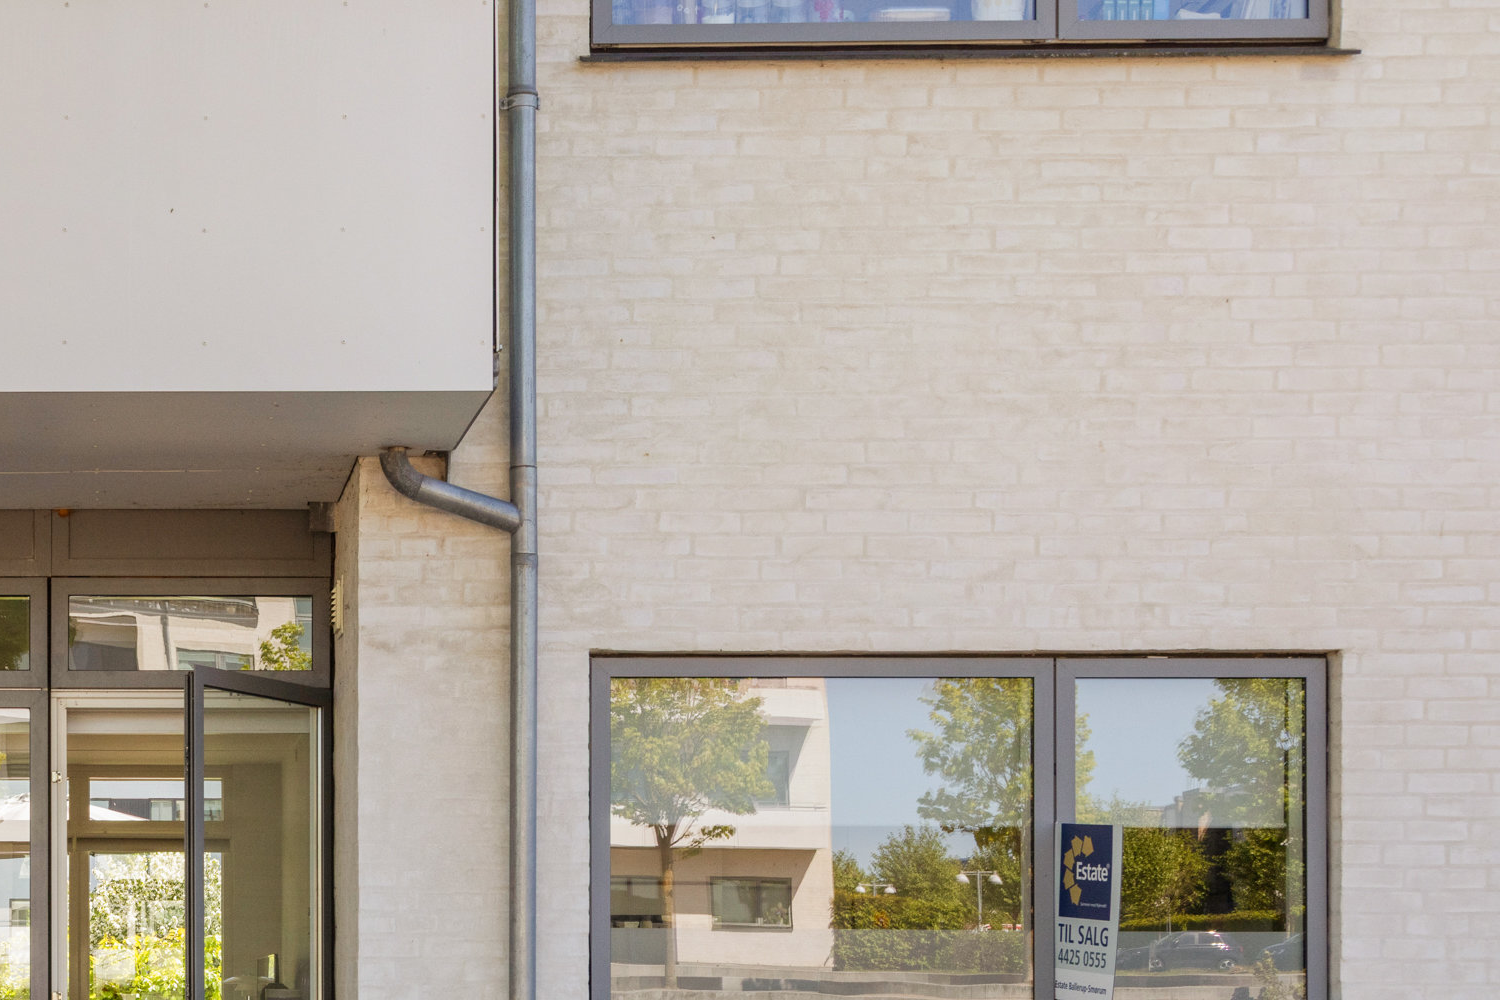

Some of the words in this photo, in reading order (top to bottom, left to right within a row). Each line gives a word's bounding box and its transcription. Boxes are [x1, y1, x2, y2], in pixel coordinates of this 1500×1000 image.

[1076, 862, 1109, 882] Estate
[1058, 923, 1074, 944] TIL
[1078, 925, 1108, 947] SALG
[1058, 948, 1080, 966] 4425
[1083, 951, 1107, 968] 0555
